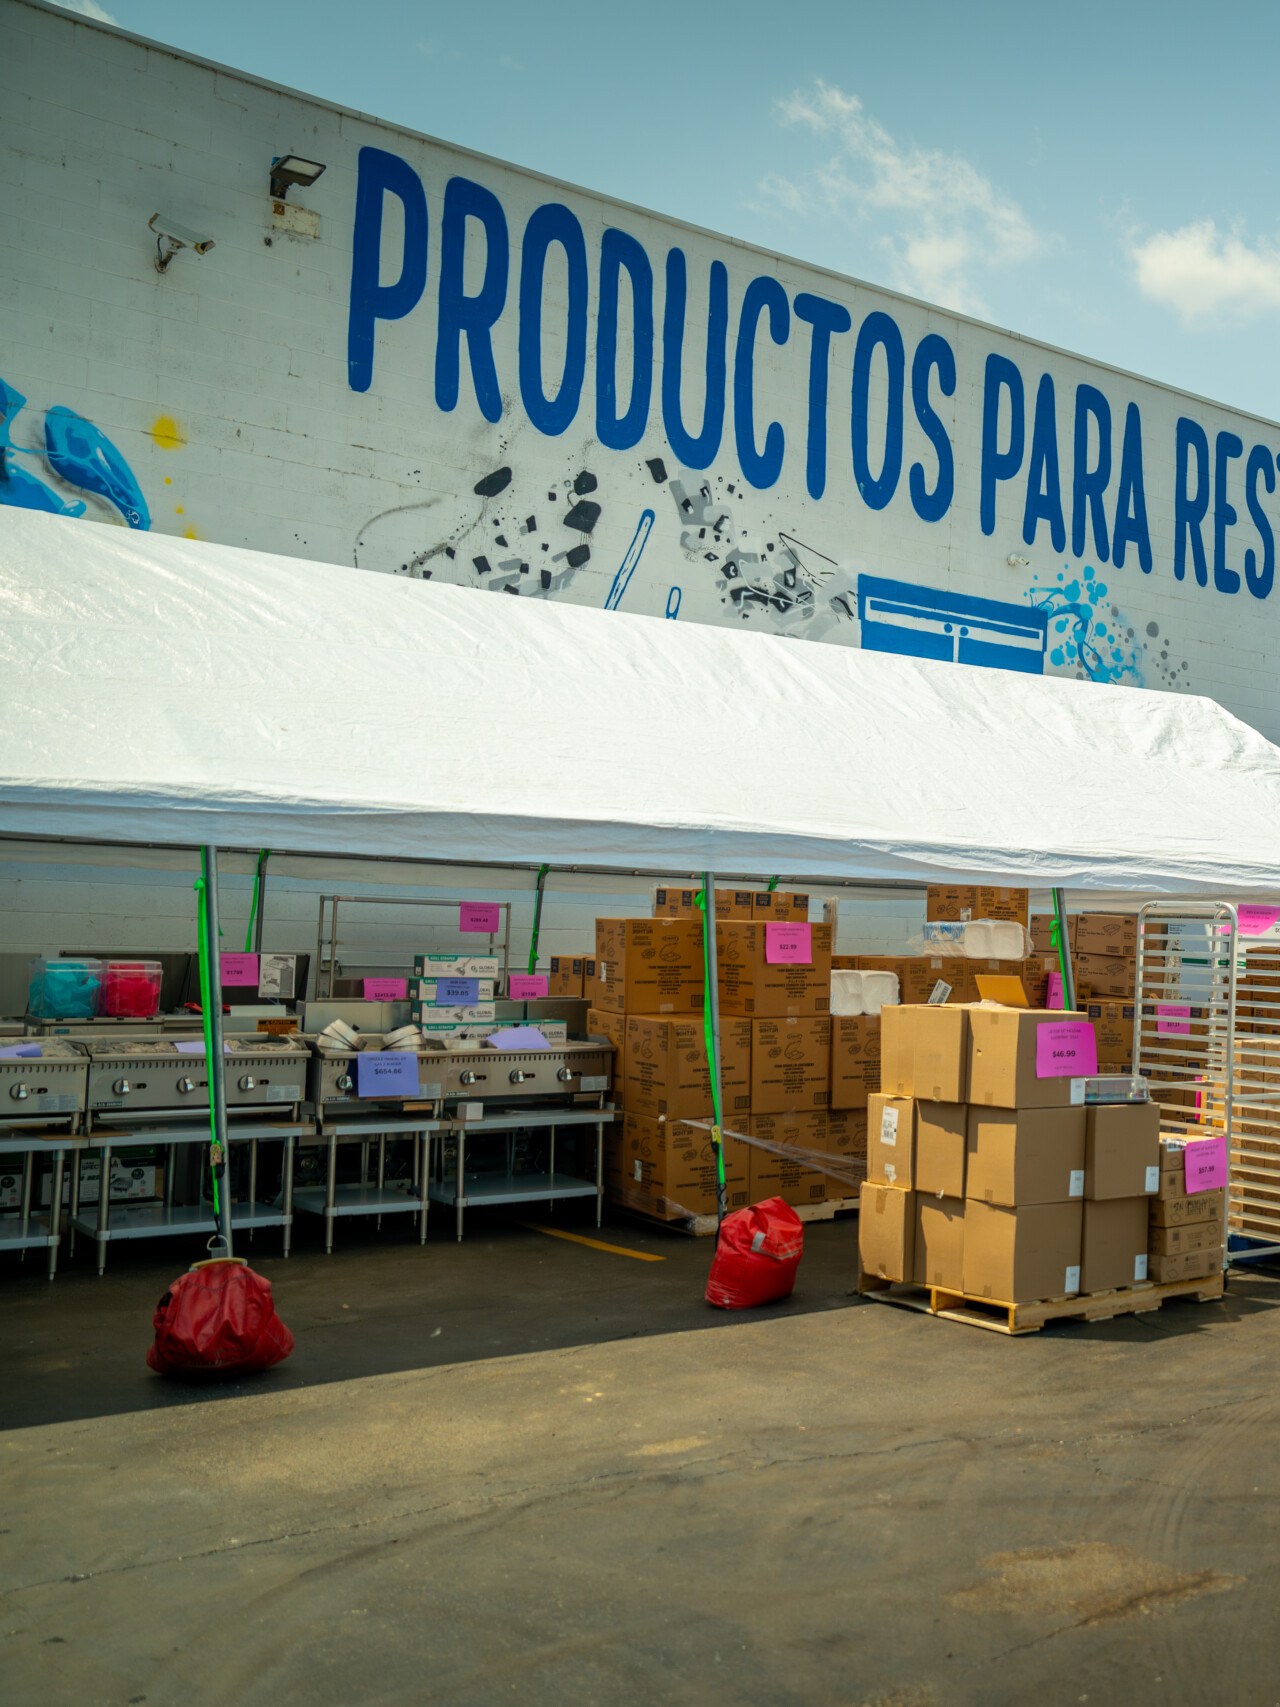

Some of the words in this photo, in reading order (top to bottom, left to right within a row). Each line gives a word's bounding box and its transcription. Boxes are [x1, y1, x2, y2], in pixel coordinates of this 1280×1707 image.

[347, 145, 957, 523] PRODUCTOS
[980, 352, 1154, 575] PARA
[1052, 1050, 1076, 1058] $46.99
[1198, 1165, 1215, 1175] $57.99
